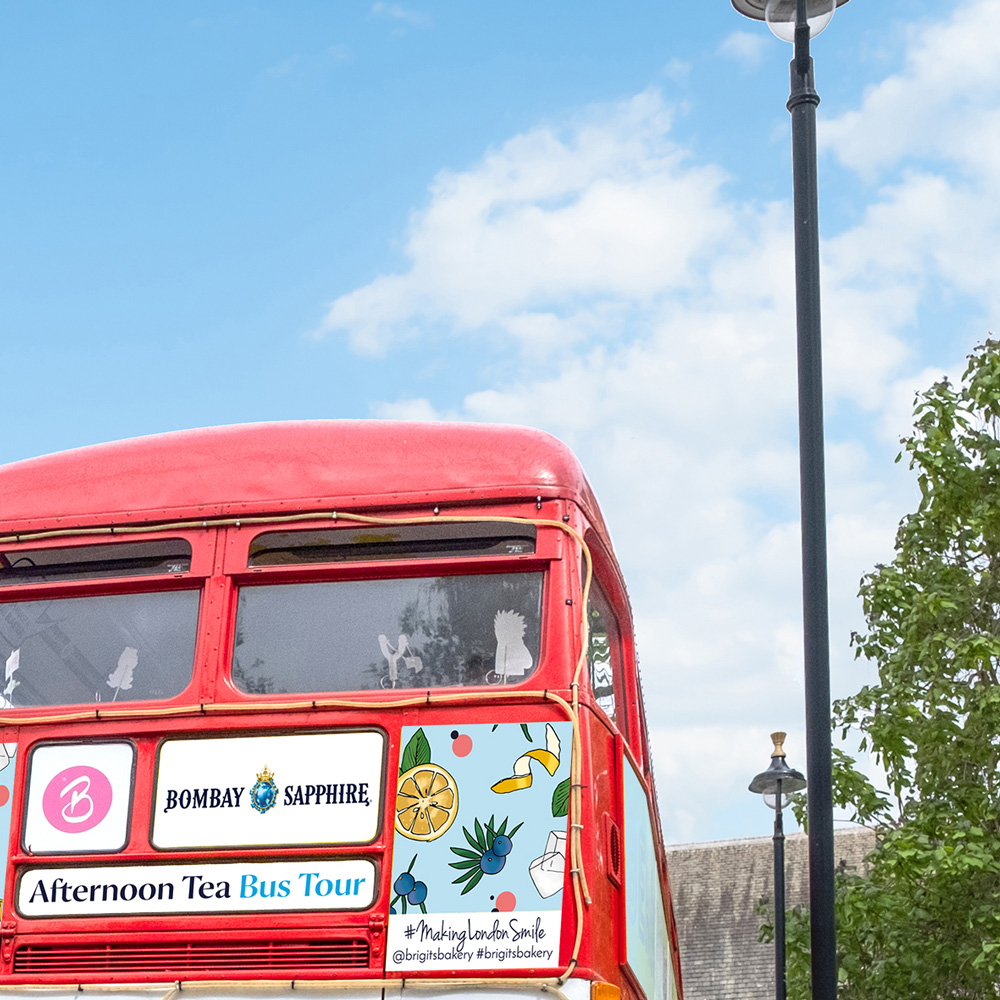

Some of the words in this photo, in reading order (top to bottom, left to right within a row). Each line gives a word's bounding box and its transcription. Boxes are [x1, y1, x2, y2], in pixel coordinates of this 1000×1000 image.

[163, 786, 245, 813] BOMBAY
[283, 782, 370, 807] SAPPHIRE
[29, 877, 174, 904] Afternoon
[181, 874, 231, 900] Tea
[239, 873, 291, 899] Bus
[297, 872, 366, 898] Tour
[392, 947, 474, 964] @brigitsbakery
[476, 945, 554, 962] #brigitsbakery
